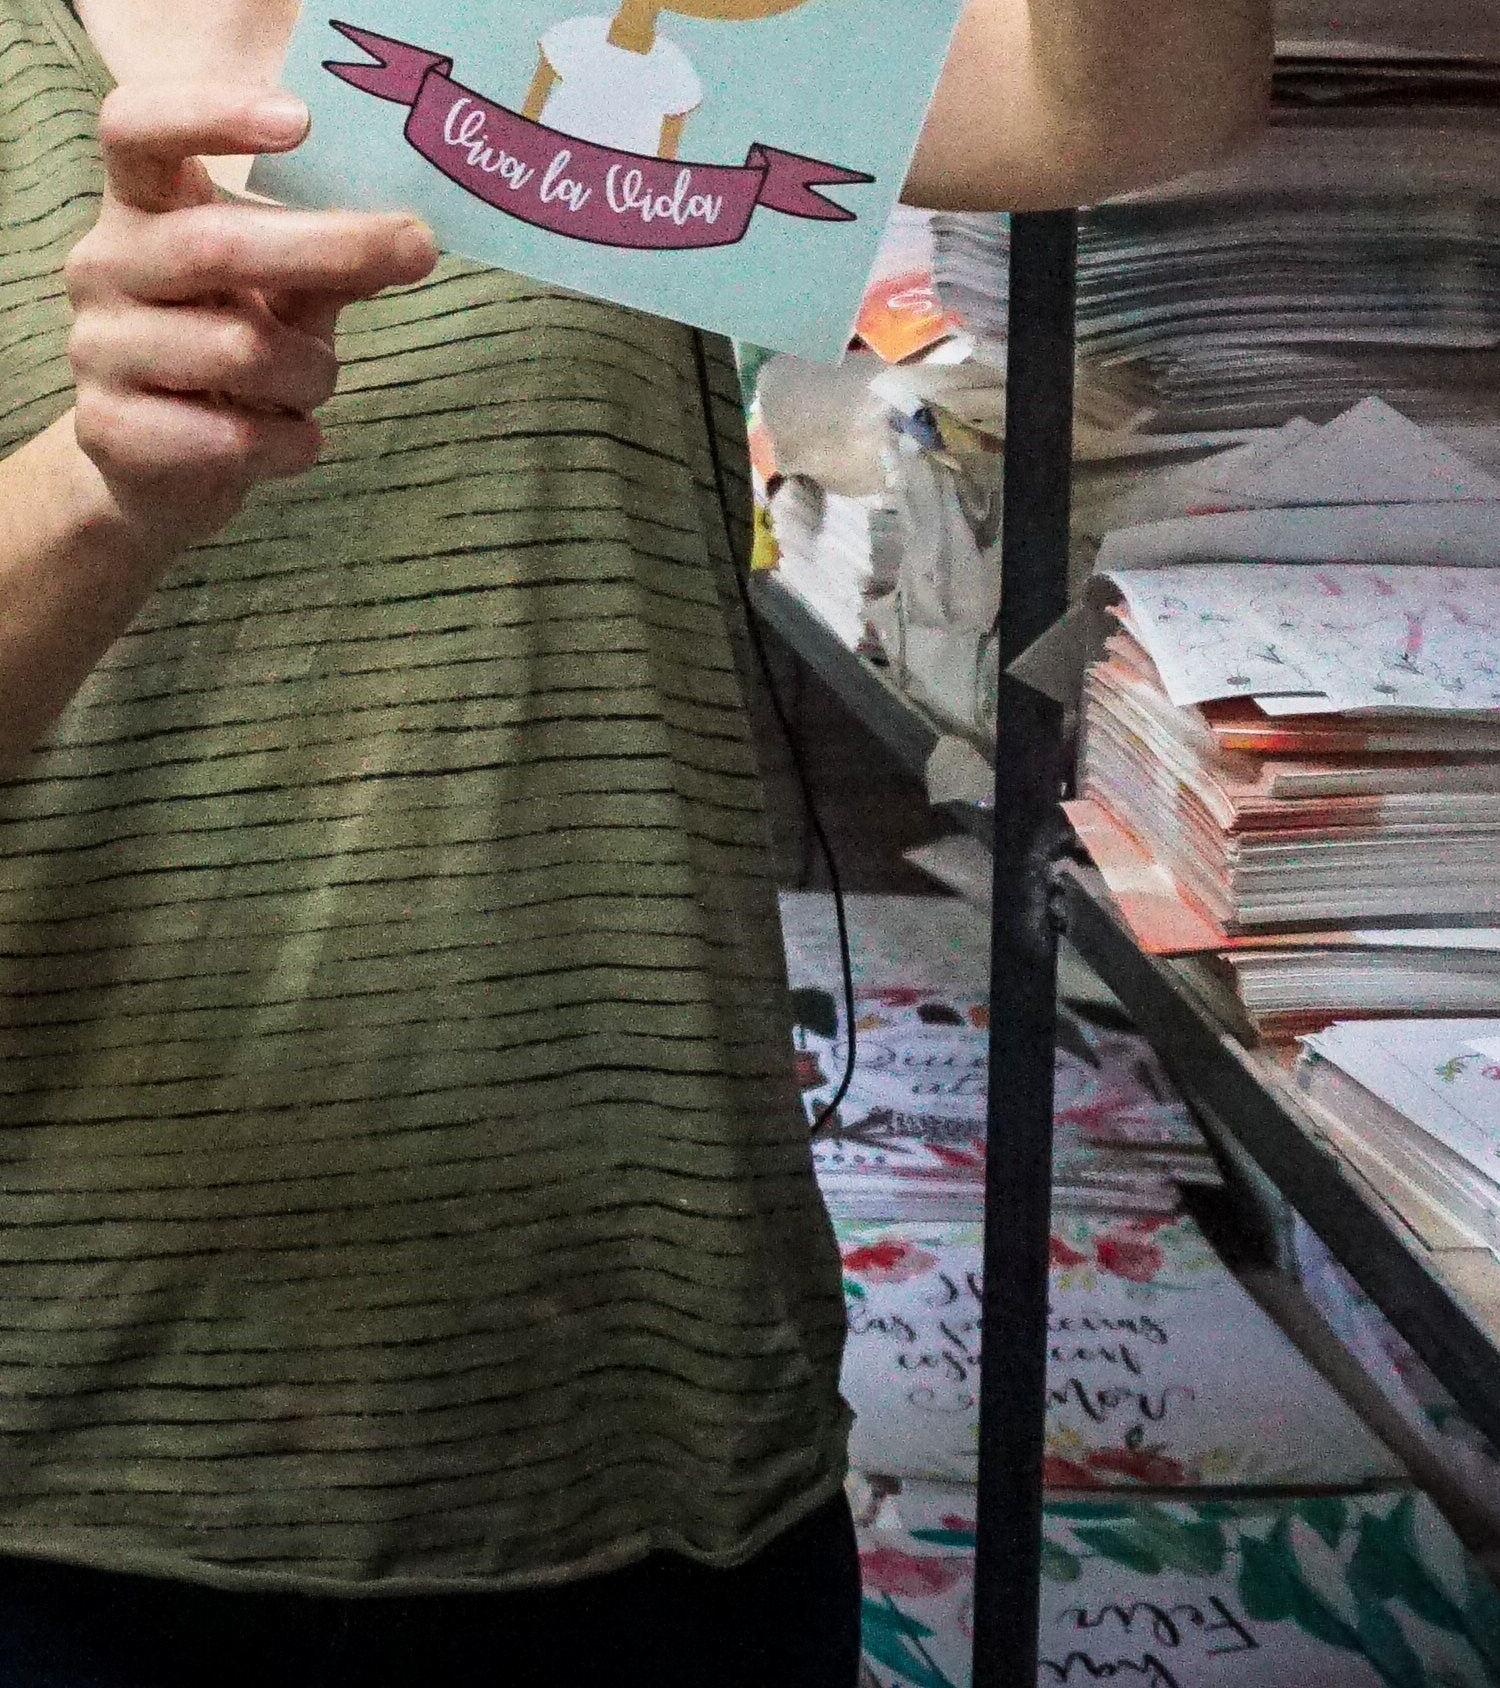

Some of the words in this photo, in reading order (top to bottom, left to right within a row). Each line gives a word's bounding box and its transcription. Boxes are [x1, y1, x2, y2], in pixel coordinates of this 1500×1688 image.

[443, 97, 536, 191] Viva
[540, 149, 593, 212] la
[605, 163, 723, 226] Vida
